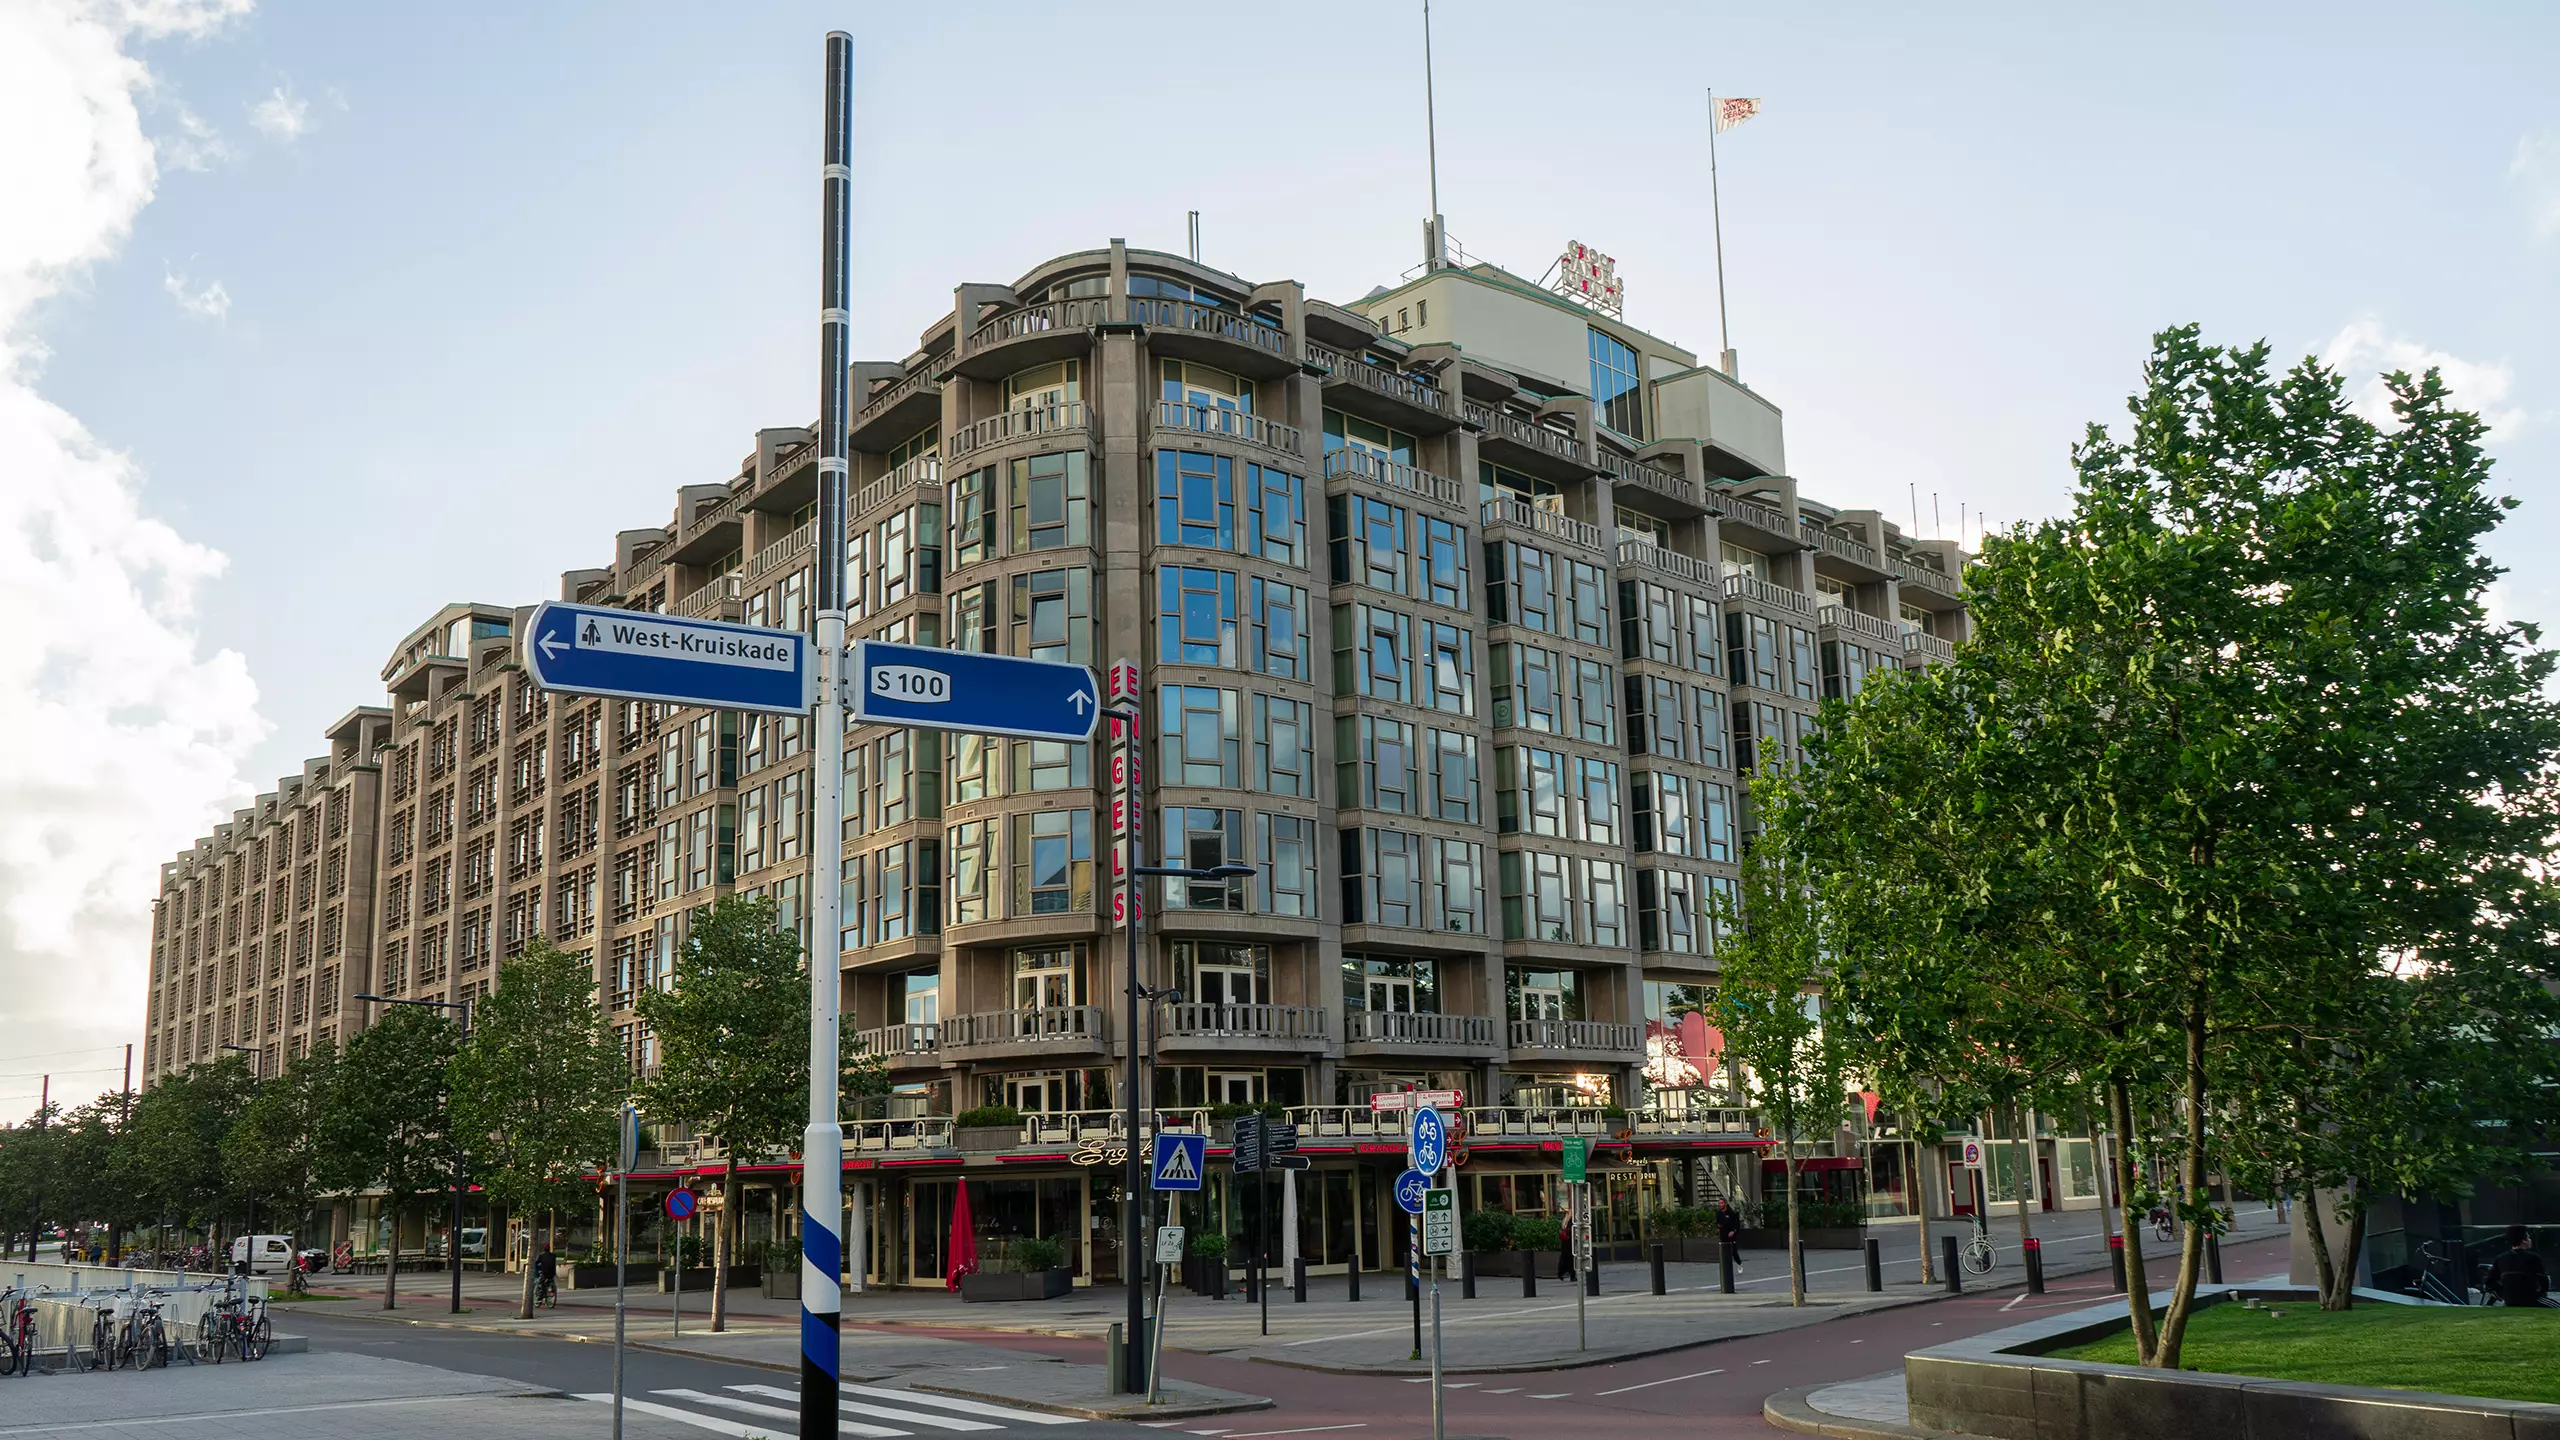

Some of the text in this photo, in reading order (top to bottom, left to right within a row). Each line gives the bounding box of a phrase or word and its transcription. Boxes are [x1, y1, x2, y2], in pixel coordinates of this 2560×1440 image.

[613, 625, 788, 662] West-Kruiskade
[877, 671, 943, 696] S 100
[1111, 665, 1124, 921] ENGELS
[1071, 1138, 1152, 1166] Engl
[1361, 1144, 1408, 1152] GRANDCA
[842, 1160, 873, 1169] URANT
